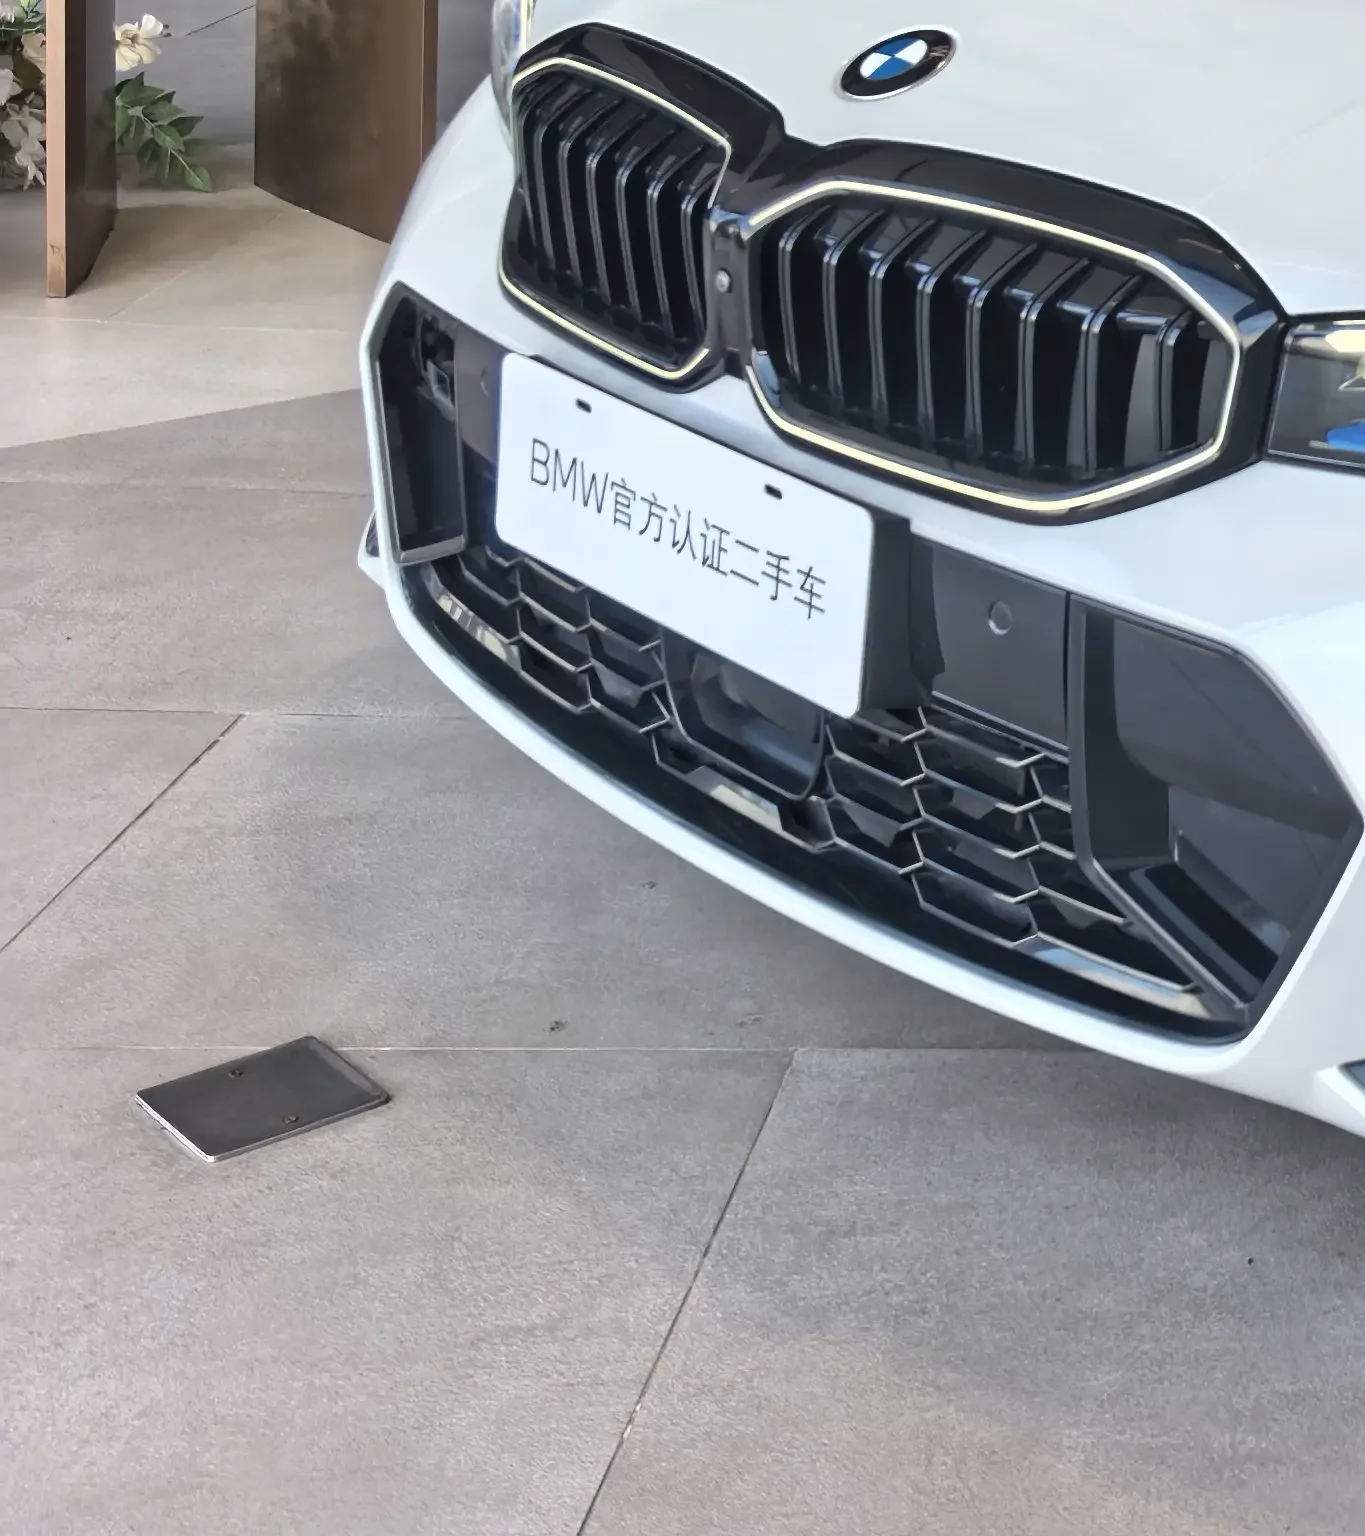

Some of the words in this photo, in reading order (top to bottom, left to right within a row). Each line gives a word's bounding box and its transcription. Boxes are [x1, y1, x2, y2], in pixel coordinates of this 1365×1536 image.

[531, 438, 826, 619] BMW官方认证二手车
